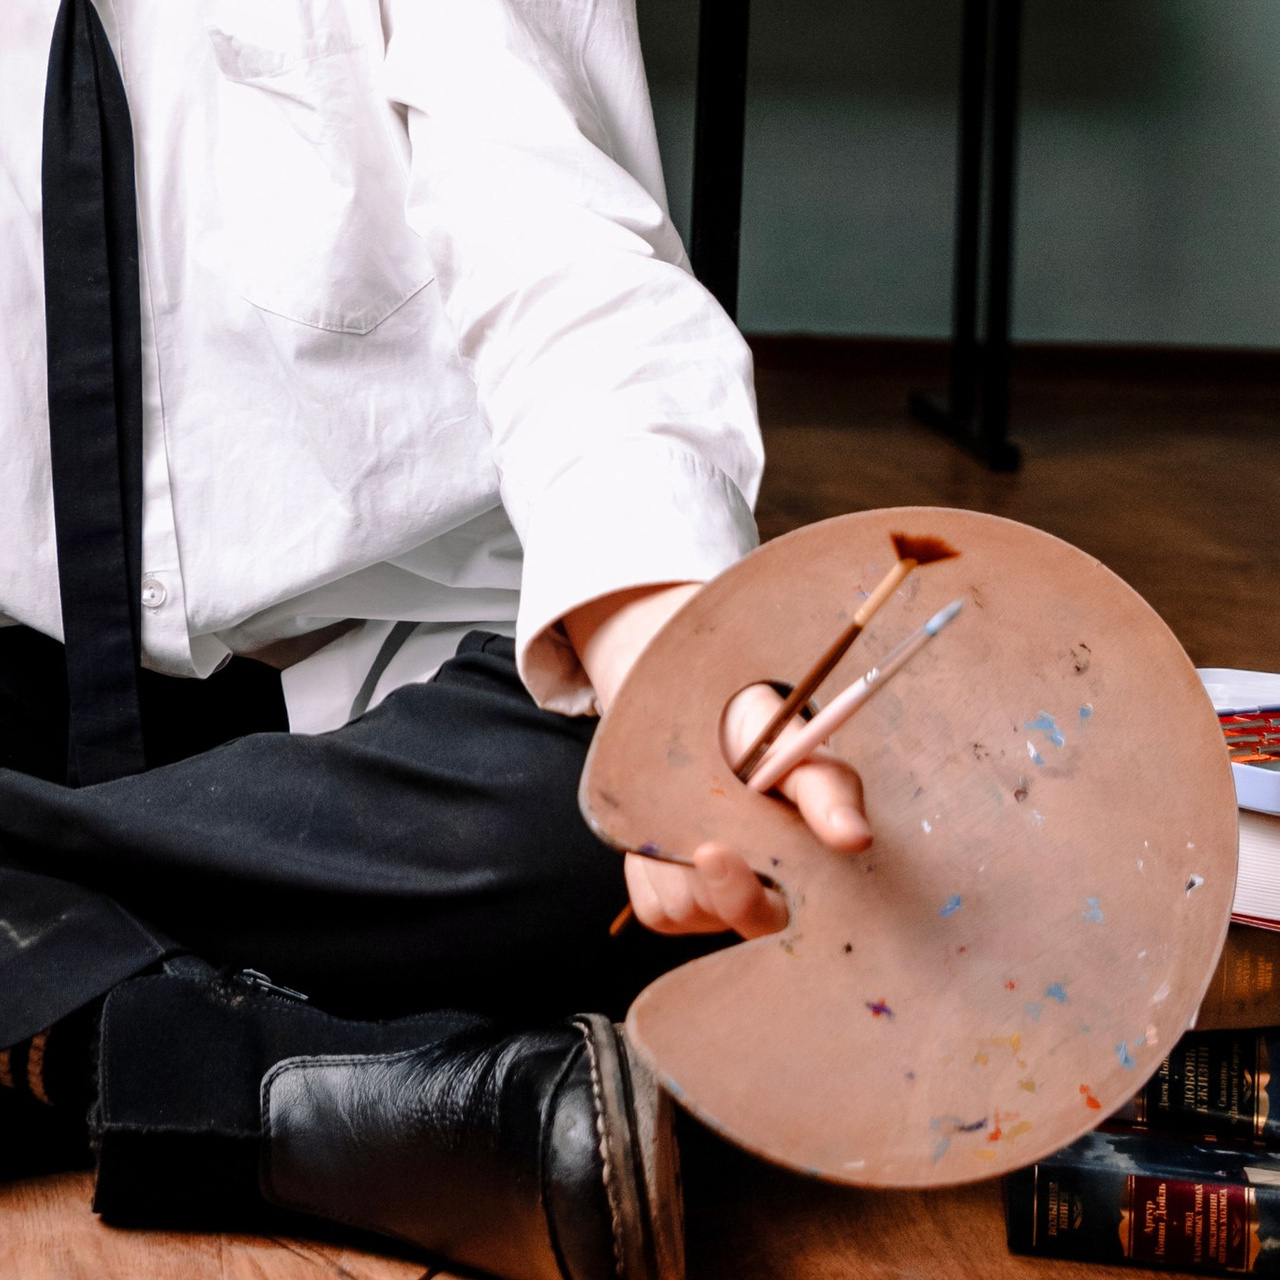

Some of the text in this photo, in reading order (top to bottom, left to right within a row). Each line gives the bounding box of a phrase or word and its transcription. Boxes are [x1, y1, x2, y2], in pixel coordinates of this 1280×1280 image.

[1183, 1048, 1196, 1109] ЛЮБОВЬ
[1153, 1183, 1167, 1219] Дойль
[1195, 1184, 1203, 1212] ТОНАХ
[1144, 1200, 1156, 1235] Артур
